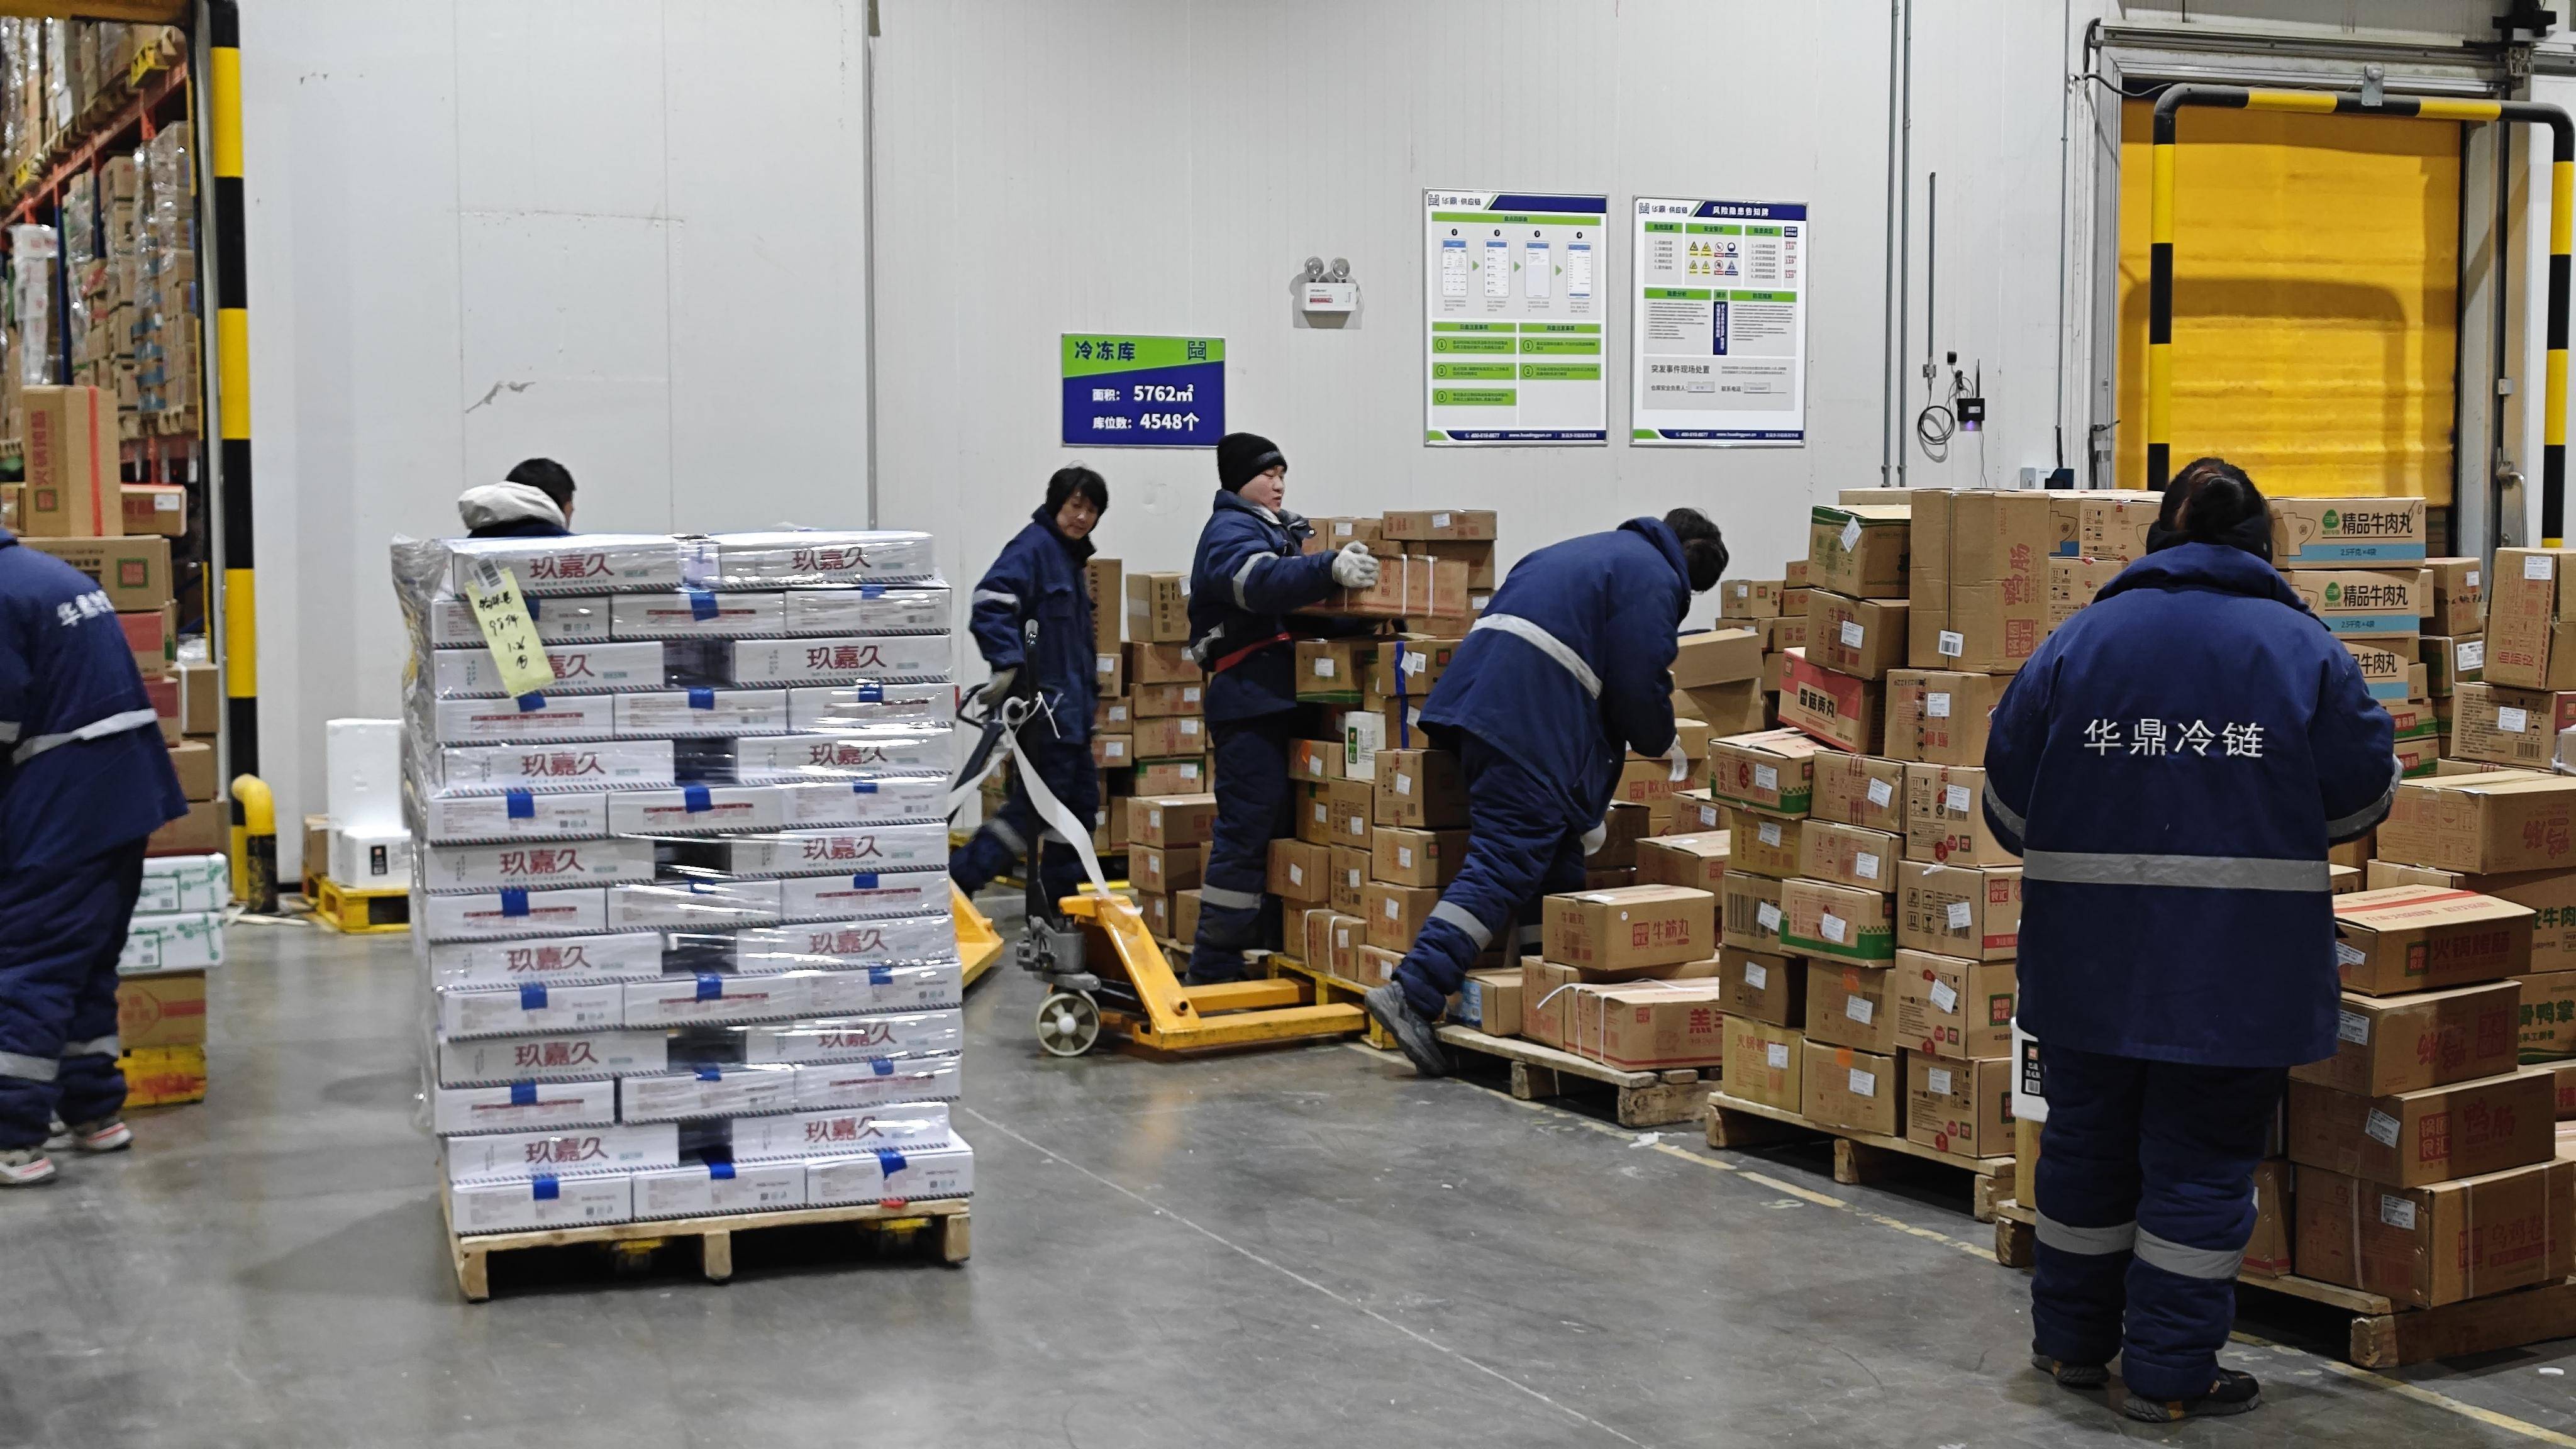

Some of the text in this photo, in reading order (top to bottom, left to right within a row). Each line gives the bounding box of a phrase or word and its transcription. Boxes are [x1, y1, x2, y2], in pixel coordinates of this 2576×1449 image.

[1712, 206, 1770, 217] 风险隐患告知牌
[1074, 340, 1136, 361] 冷冻库
[1651, 365, 1710, 374] 突发事件现场处置
[1092, 388, 1121, 402] 面积：
[1092, 413, 1200, 431] 库位数： 4548个
[2341, 511, 2412, 535] 精品牛肉丸
[530, 553, 615, 580] 玖嘉久
[791, 547, 872, 571] 玖嘉久
[2004, 543, 2031, 606] 鸭肠
[2343, 584, 2408, 607] 精品牛肉丸
[547, 654, 596, 680] 嘉久
[806, 644, 887, 671] 玖嘉久
[2497, 650, 2535, 667] 面筋皮
[1799, 687, 1835, 719] 香菇贡丸
[2083, 718, 2265, 758] 华鼎冷链
[521, 750, 606, 777] 玖嘉久
[803, 835, 883, 861] 玖嘉久
[499, 848, 585, 876] 玖嘉久
[809, 929, 889, 955] 玖嘉久
[1653, 918, 1690, 940] 牛筋丸
[2433, 931, 2511, 959] 火锅烤肠
[508, 945, 592, 972] 玖嘉久
[514, 1041, 599, 1067] 玖嘉久
[804, 1115, 884, 1143] 玖嘉久
[2463, 1098, 2516, 1137] 鸭肠
[525, 1136, 609, 1163] 玖嘉久
